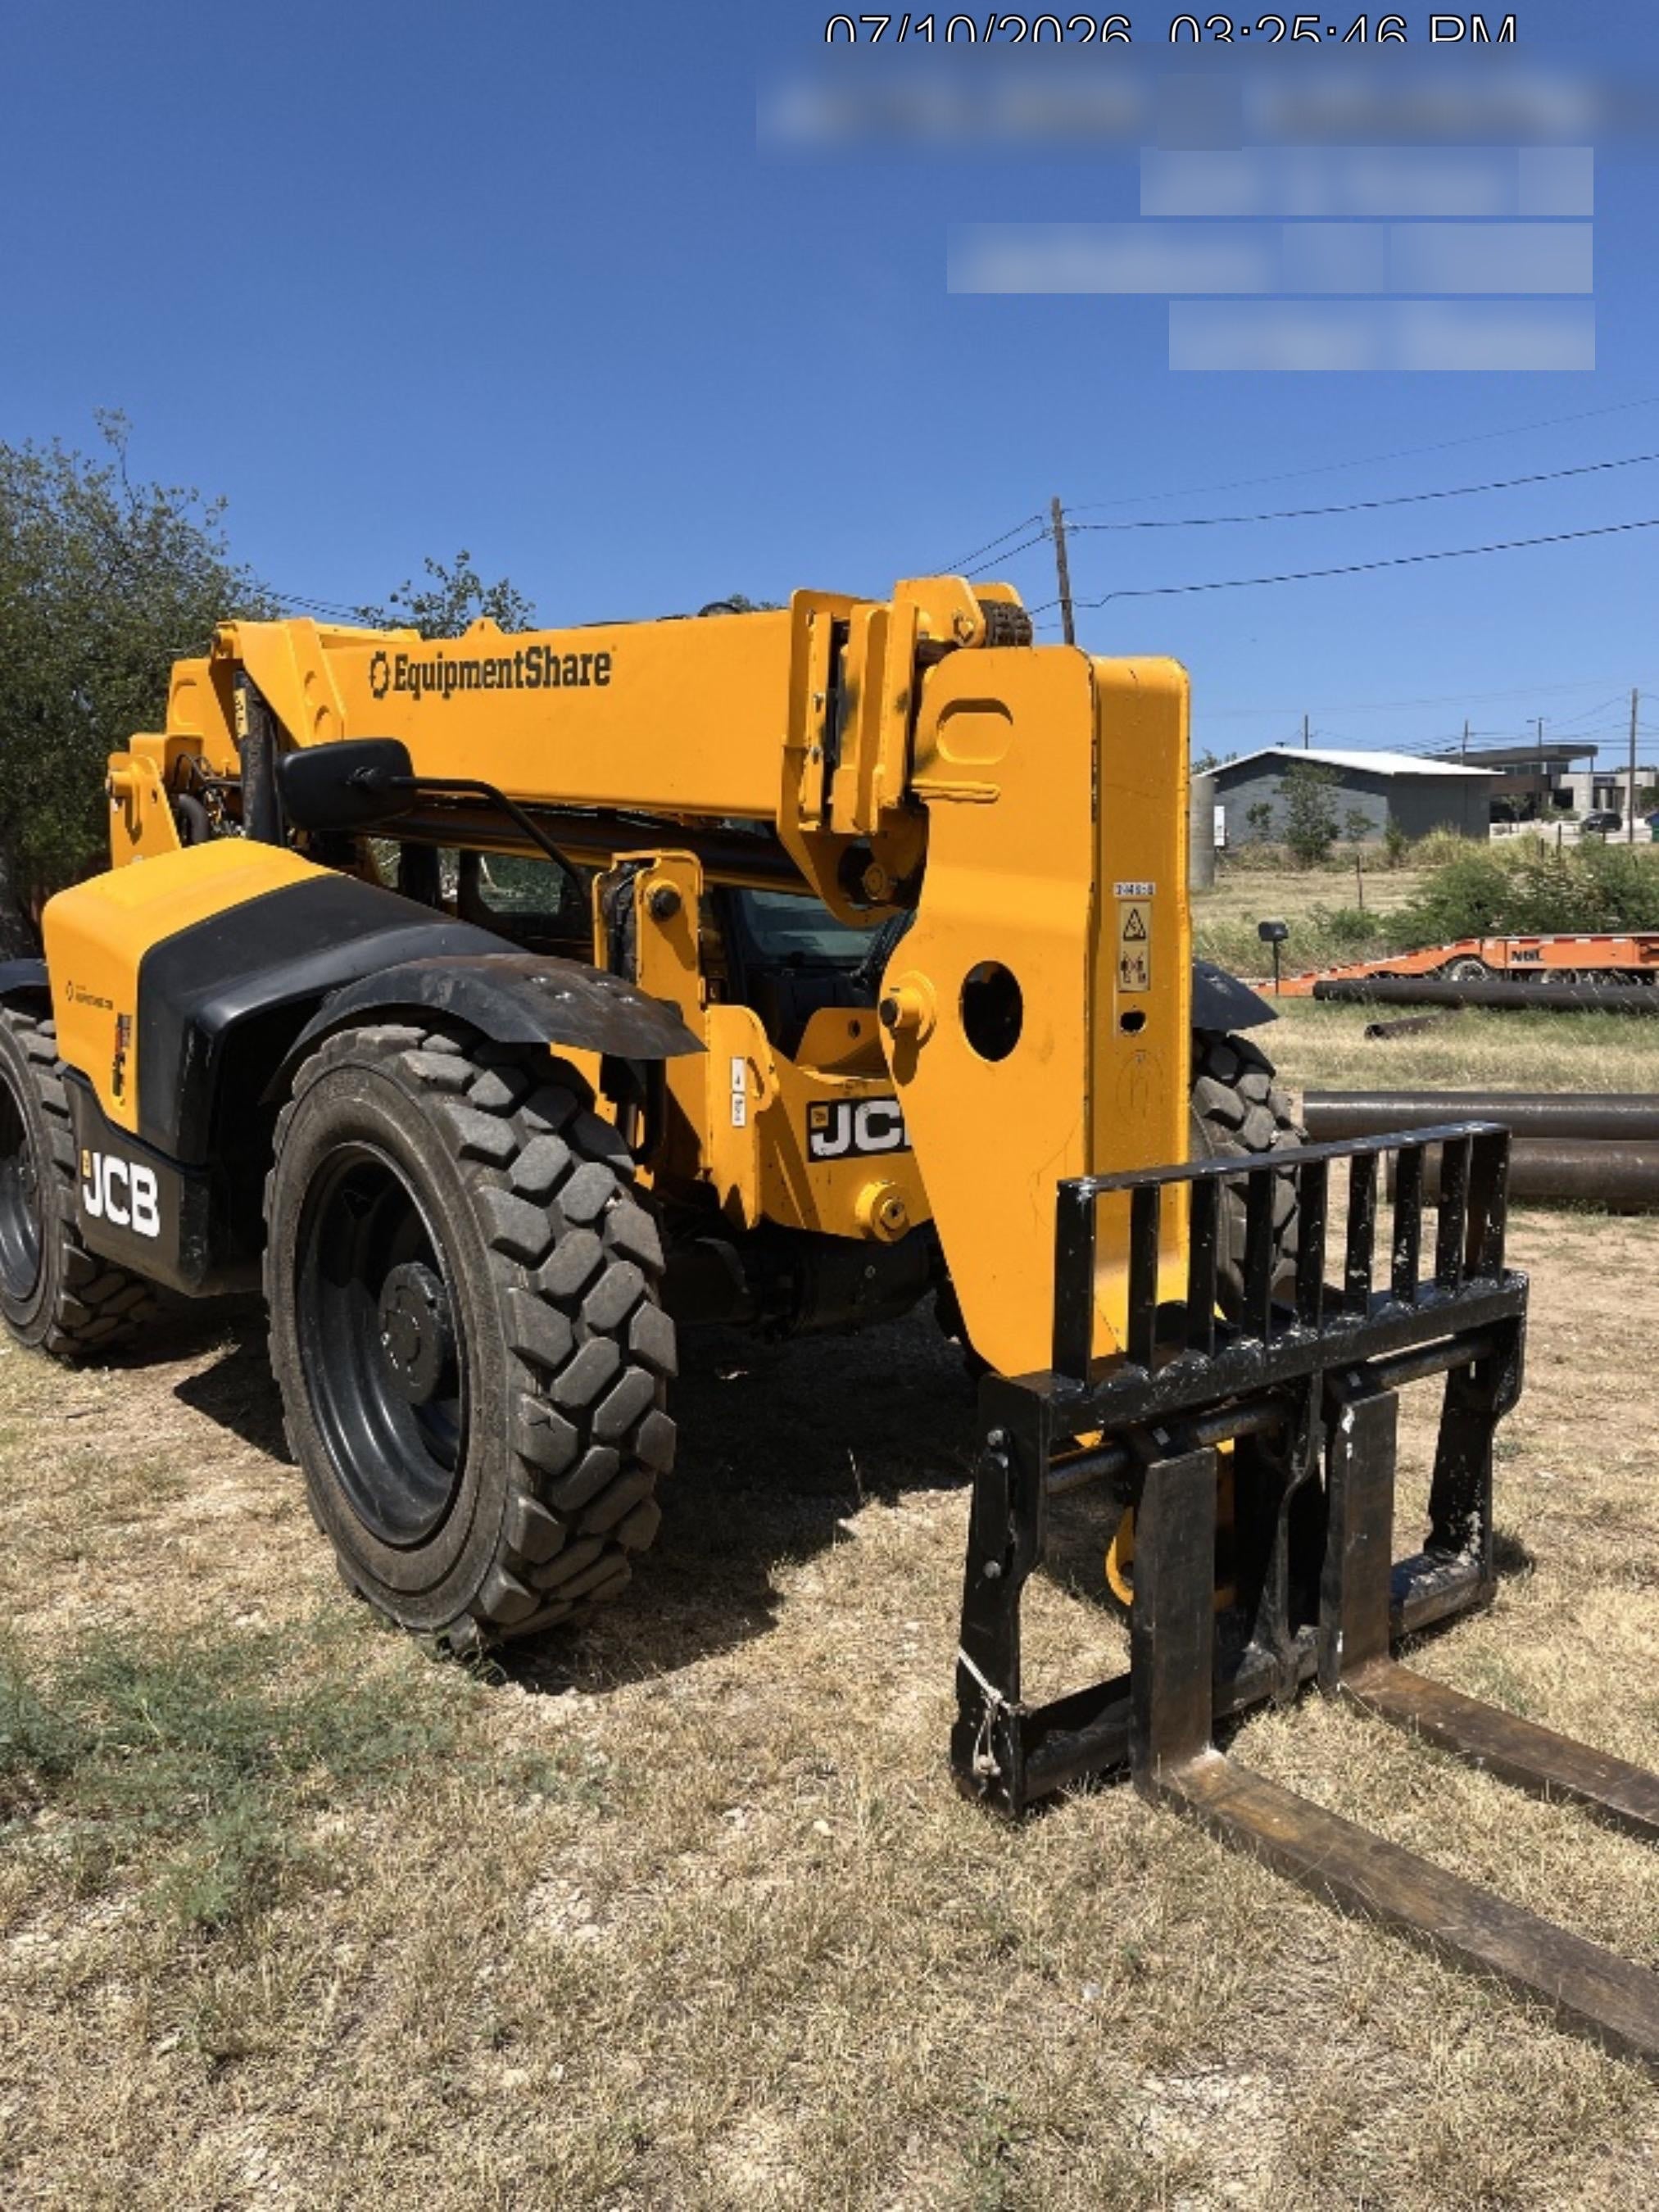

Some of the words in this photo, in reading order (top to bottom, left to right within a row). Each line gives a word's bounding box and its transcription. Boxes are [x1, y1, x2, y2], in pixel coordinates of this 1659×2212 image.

[392, 644, 611, 701] EquipmentShare
[810, 1100, 910, 1156] JC
[83, 1151, 161, 1238] JCB
